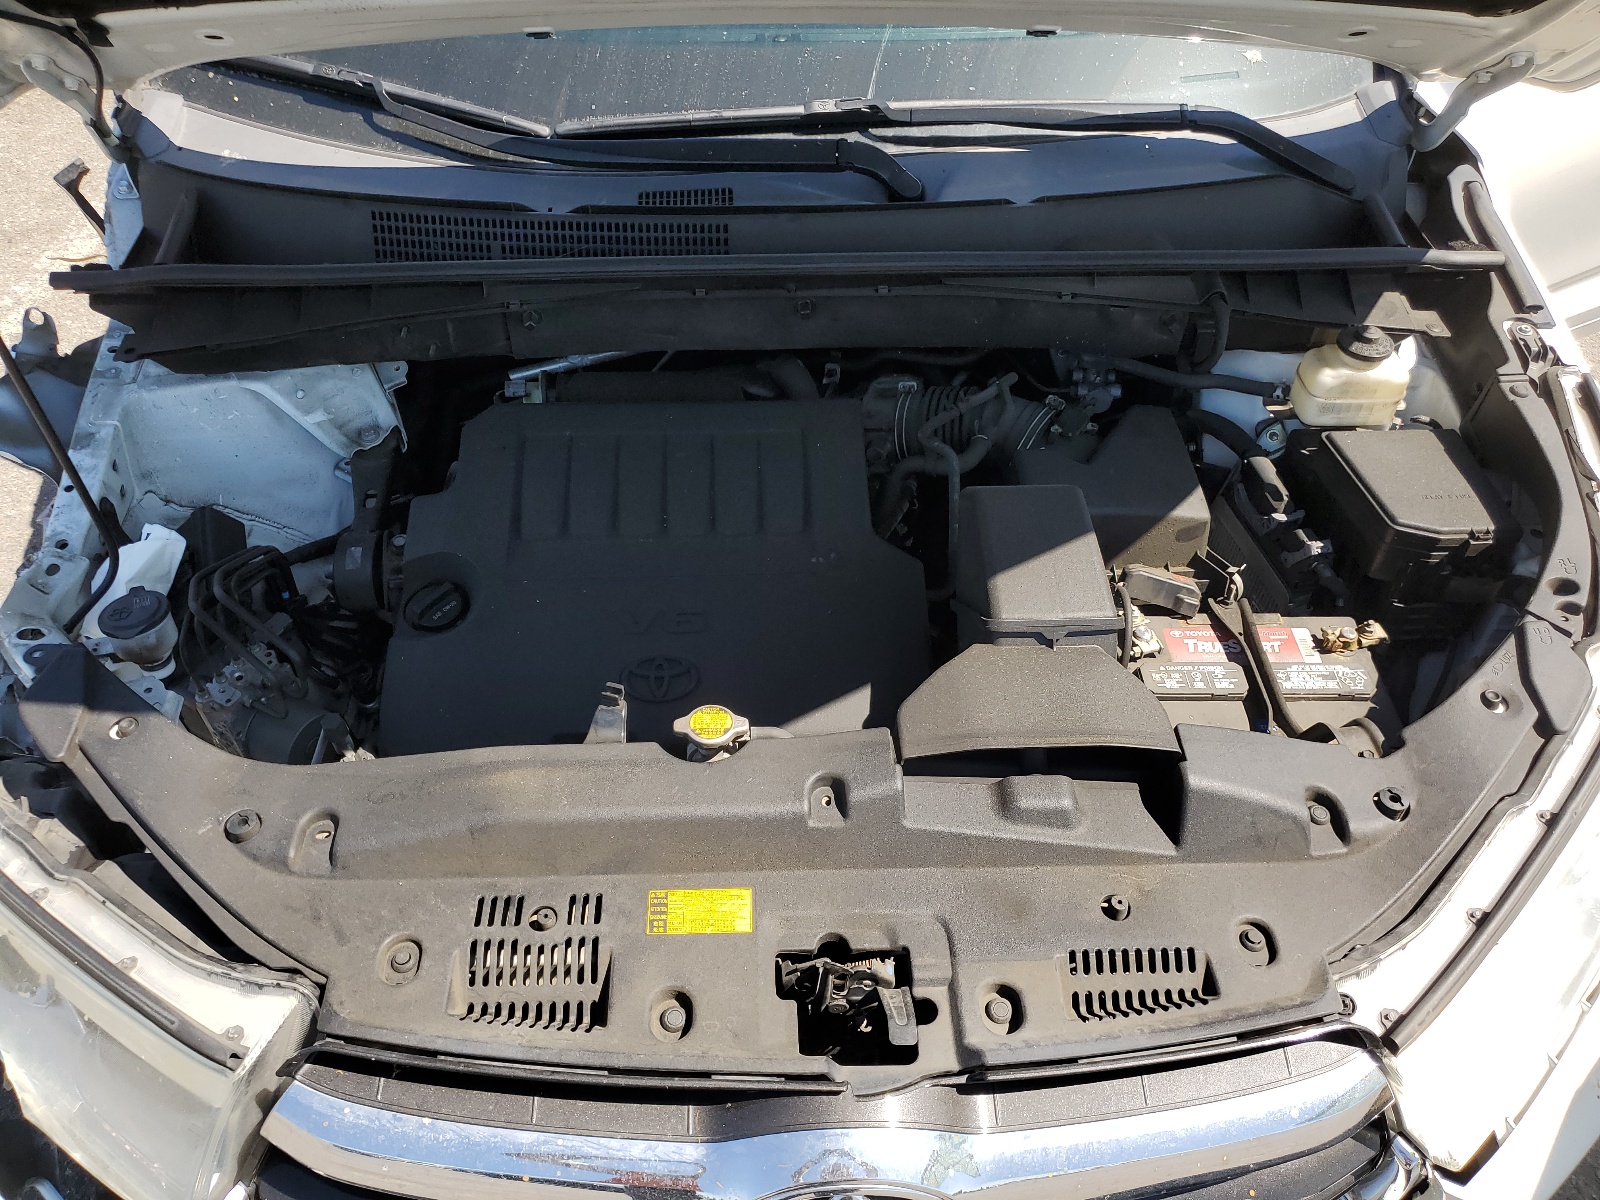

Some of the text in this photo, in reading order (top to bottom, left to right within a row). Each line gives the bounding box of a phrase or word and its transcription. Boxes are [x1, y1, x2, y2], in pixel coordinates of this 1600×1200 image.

[623, 611, 709, 634] V6
[1185, 630, 1221, 638] TOYOTA
[1183, 639, 1282, 653] TRUESRT
